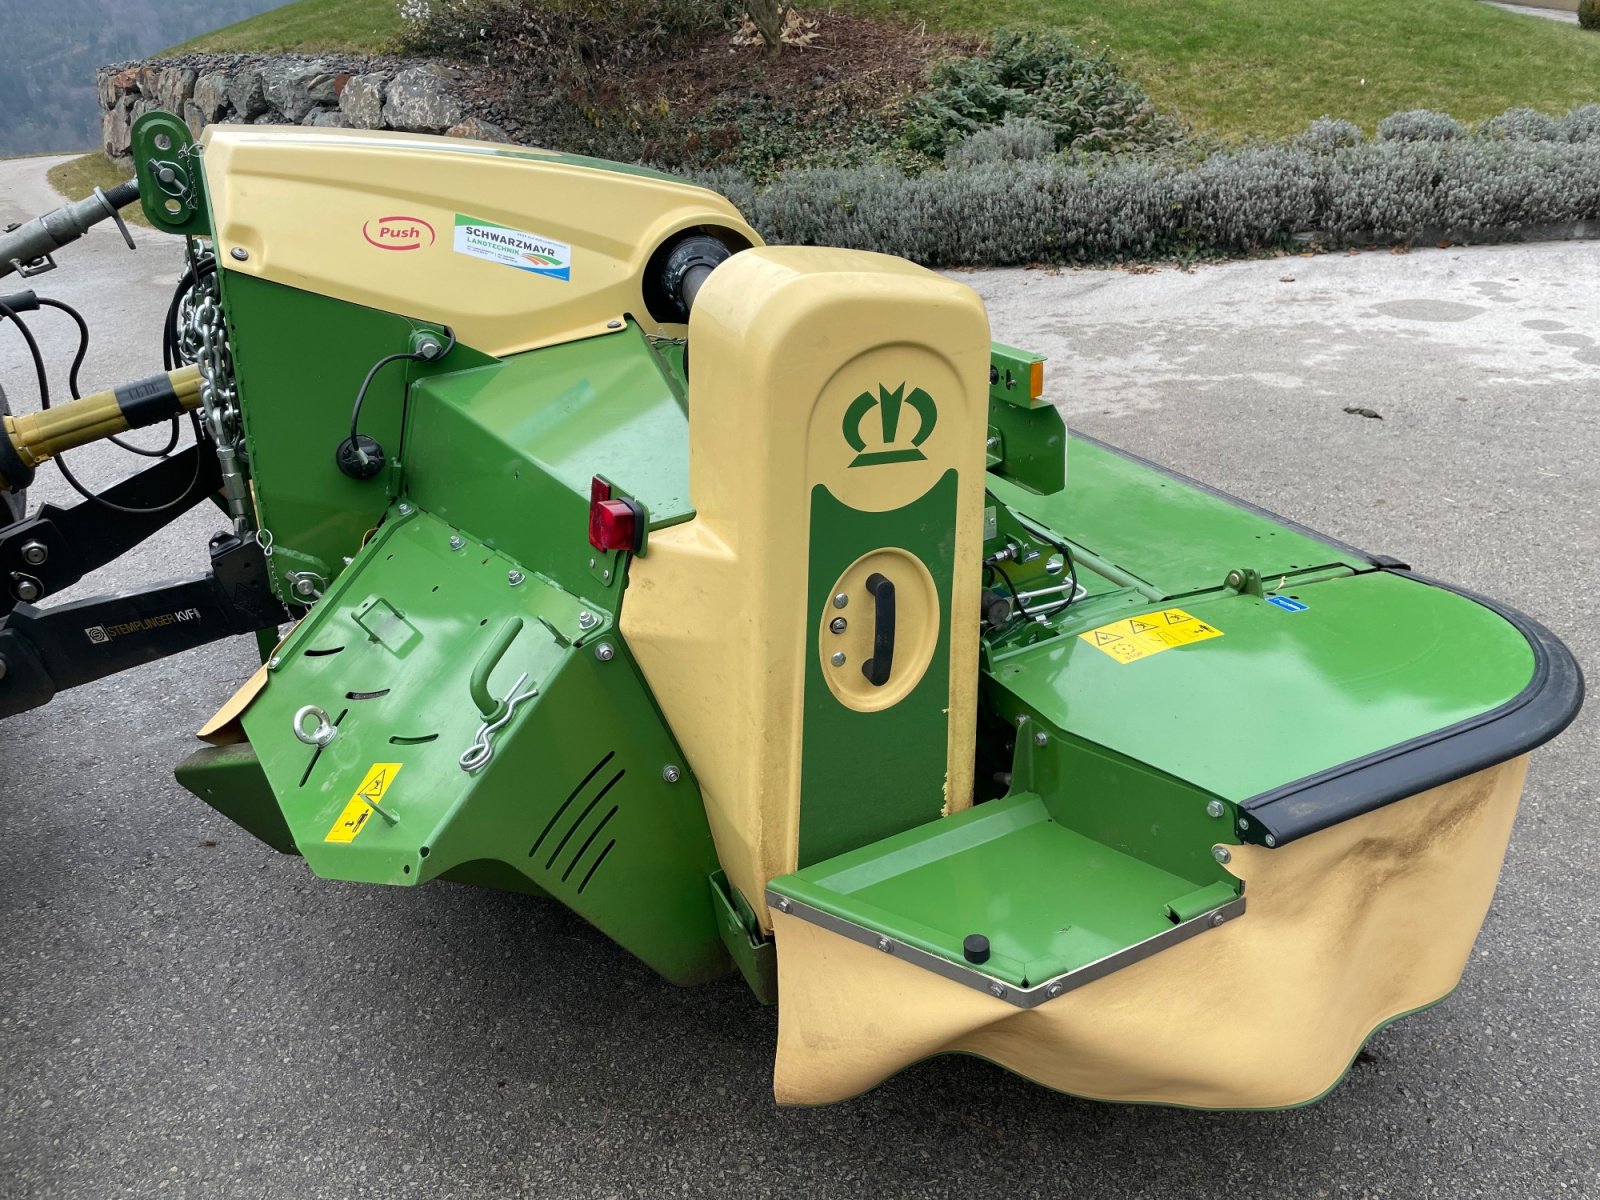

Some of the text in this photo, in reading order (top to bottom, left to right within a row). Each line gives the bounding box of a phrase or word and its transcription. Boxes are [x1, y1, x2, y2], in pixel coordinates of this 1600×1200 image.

[380, 226, 420, 238] Push
[466, 226, 555, 257] SCHWARZMAYR
[467, 237, 520, 256] LANDTECHNIK
[106, 613, 176, 637] STEMPLINGER
[175, 608, 195, 622] KVF
